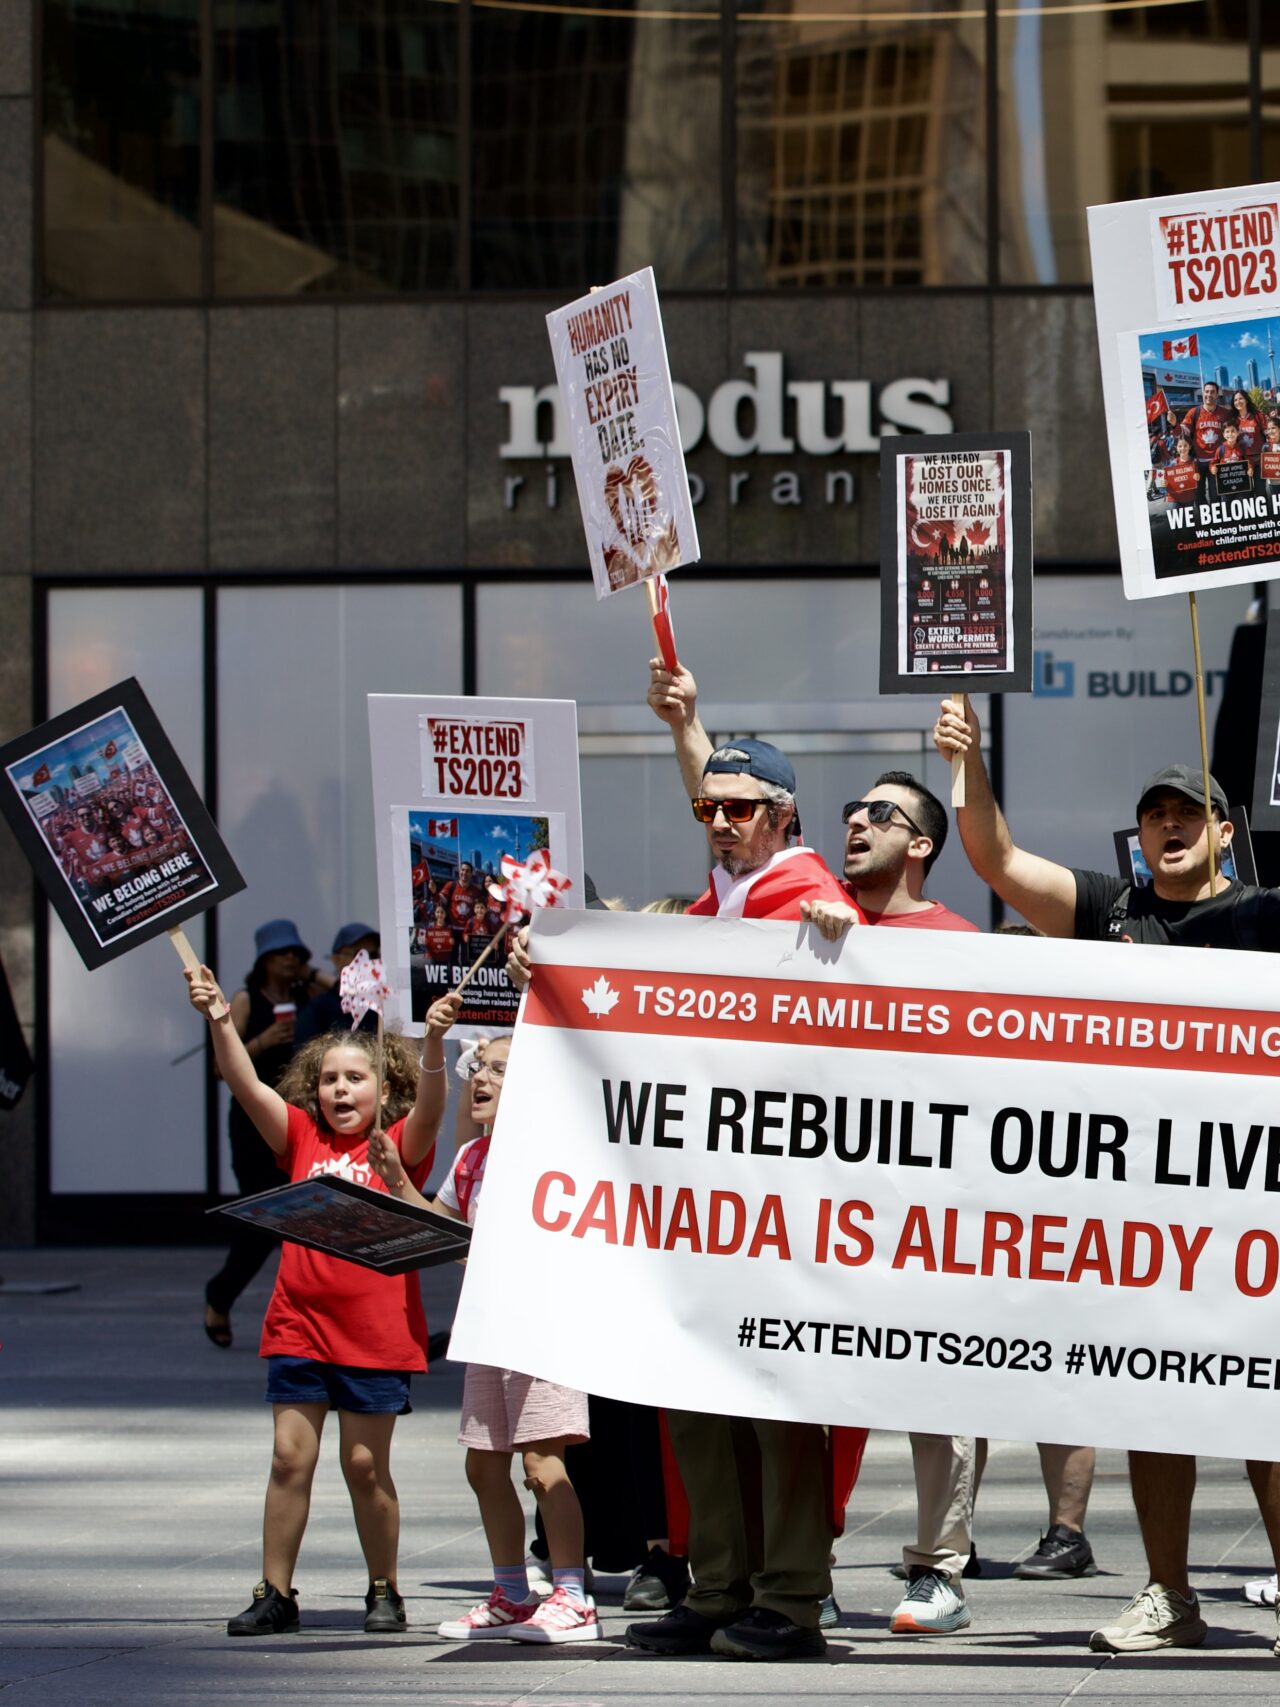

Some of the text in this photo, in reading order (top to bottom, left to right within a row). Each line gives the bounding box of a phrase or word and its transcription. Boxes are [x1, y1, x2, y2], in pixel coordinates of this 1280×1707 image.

[1167, 211, 1273, 256] #EXTEND
[1168, 249, 1277, 304] TS2023
[567, 291, 632, 356] HUMANITY
[584, 337, 629, 382] HAS NO
[585, 366, 639, 424] EXPIRY
[922, 465, 983, 480] LOST OUR
[924, 453, 980, 465] WE ALREADY
[920, 479, 994, 494] HOMES ONCE.
[928, 494, 984, 504] WE REFUSE TO
[920, 504, 998, 519] LOSE IT AGAIN.
[1166, 506, 1195, 530] WE
[1200, 496, 1267, 525] BELONG
[1178, 539, 1214, 550] Canadian
[1216, 535, 1248, 545] children
[1249, 531, 1272, 540] raised
[1196, 530, 1209, 538] We
[1210, 525, 1237, 536] belong
[1239, 523, 1256, 532] here
[1258, 520, 1275, 529] with
[928, 627, 960, 635] EXTEND
[928, 634, 995, 643] WORK PERMITS
[1088, 671, 1194, 697] BUILD
[434, 725, 519, 757] #EXTEND
[434, 757, 521, 798] TS2023
[92, 852, 192, 913] WE BELONG HERE
[425, 965, 448, 983] WE
[484, 989, 498, 997] here
[499, 989, 514, 998] with
[633, 984, 758, 1023] TS2023
[771, 994, 950, 1036] FAMILIES
[603, 1079, 687, 1149] WE
[706, 1087, 968, 1170] REBUILT
[990, 1106, 1130, 1183] OUR
[531, 1170, 792, 1260] CANADA
[815, 1198, 874, 1267] IS
[891, 1205, 1213, 1292] ALREADY
[738, 1316, 1052, 1372] #EXTENDTS2023
